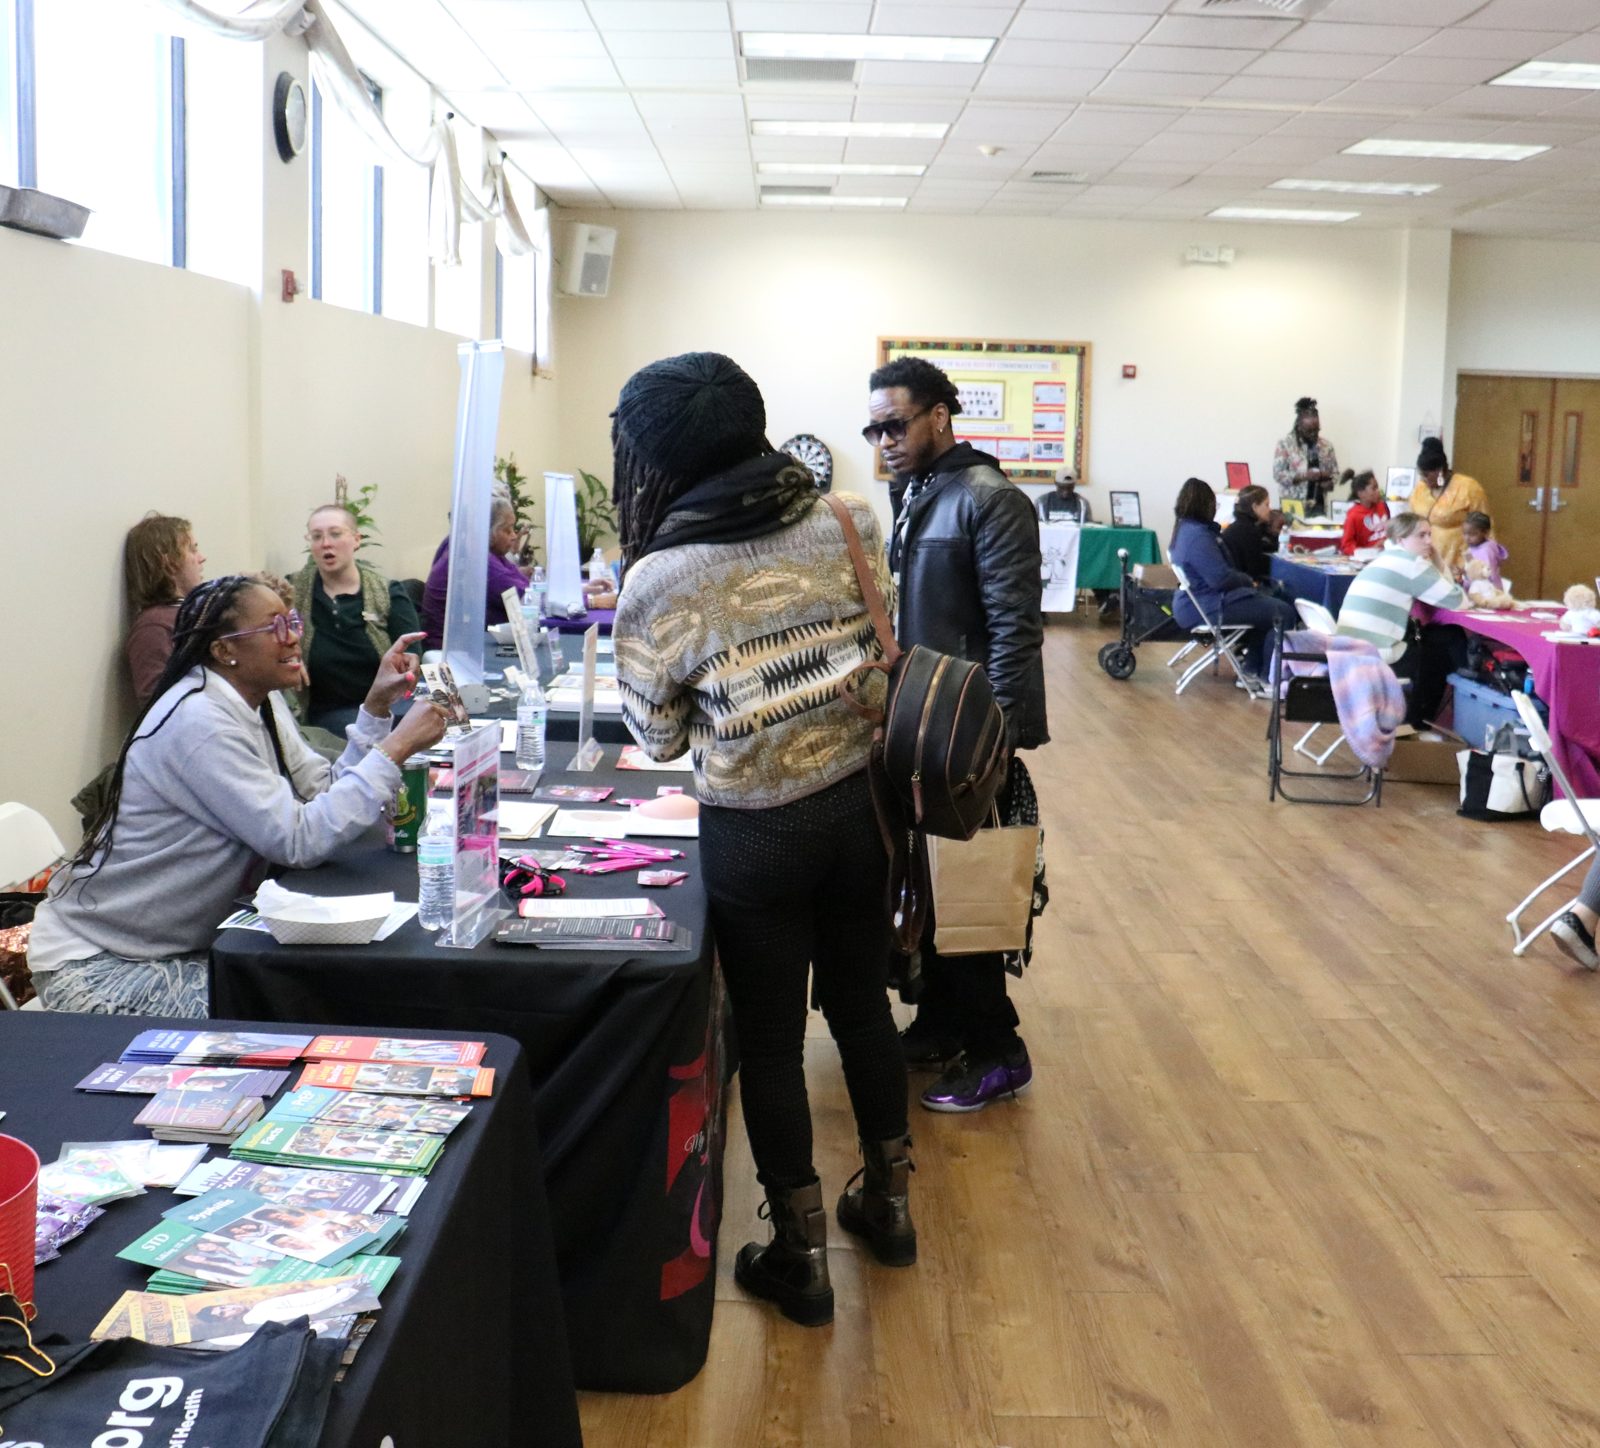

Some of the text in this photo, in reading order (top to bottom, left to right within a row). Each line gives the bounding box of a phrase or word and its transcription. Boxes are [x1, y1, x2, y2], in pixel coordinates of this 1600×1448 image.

[313, 1039, 332, 1054] HIV
[260, 1127, 285, 1145] Facts
[198, 1171, 225, 1191] HIV
[215, 1166, 252, 1190] FACTS
[187, 1199, 235, 1222] Syphilis
[141, 1233, 170, 1252] STD
[91, 1376, 184, 1448] org
[171, 1388, 205, 1438] Health
